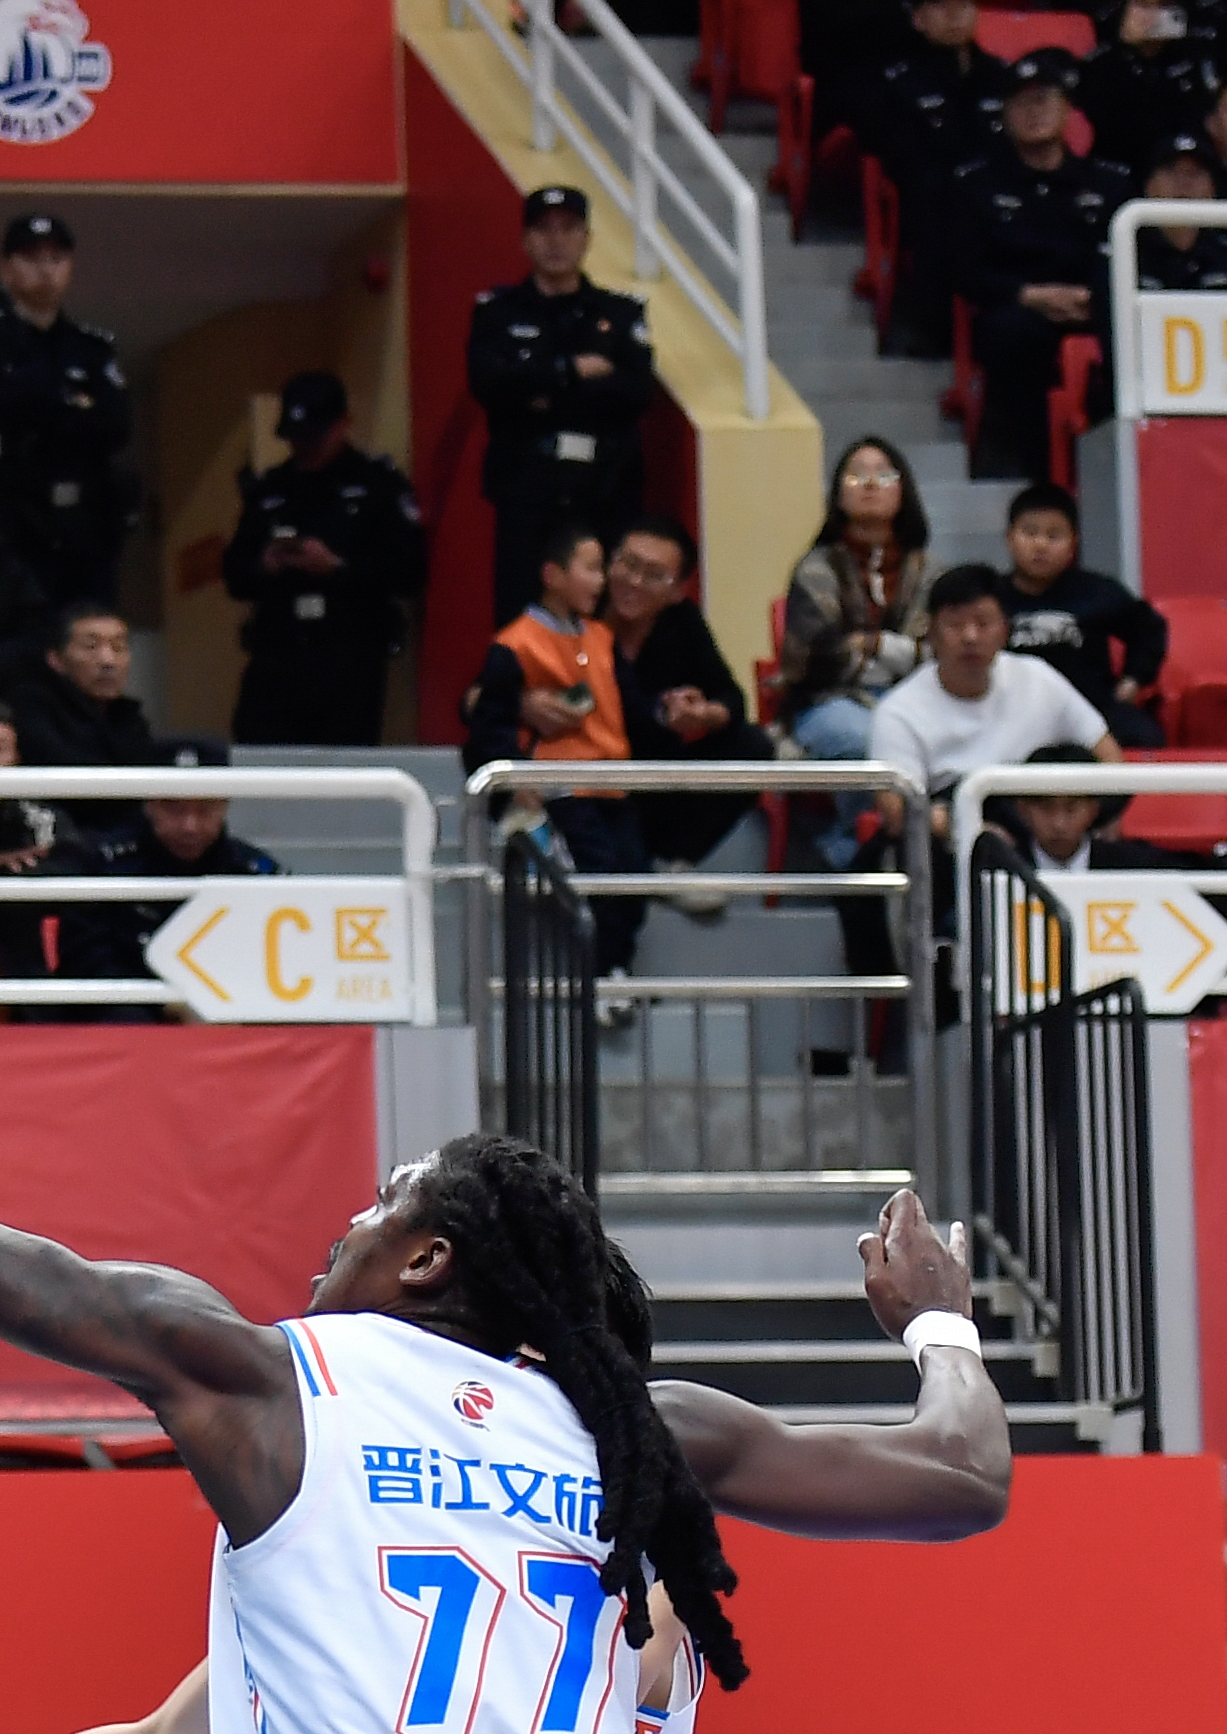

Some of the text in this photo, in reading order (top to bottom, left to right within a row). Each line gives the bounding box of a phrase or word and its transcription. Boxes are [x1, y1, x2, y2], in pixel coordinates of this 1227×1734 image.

[1162, 316, 1206, 396] D
[264, 906, 391, 1003] C 区
[1087, 902, 1140, 953] 区
[336, 978, 393, 1000] AREA
